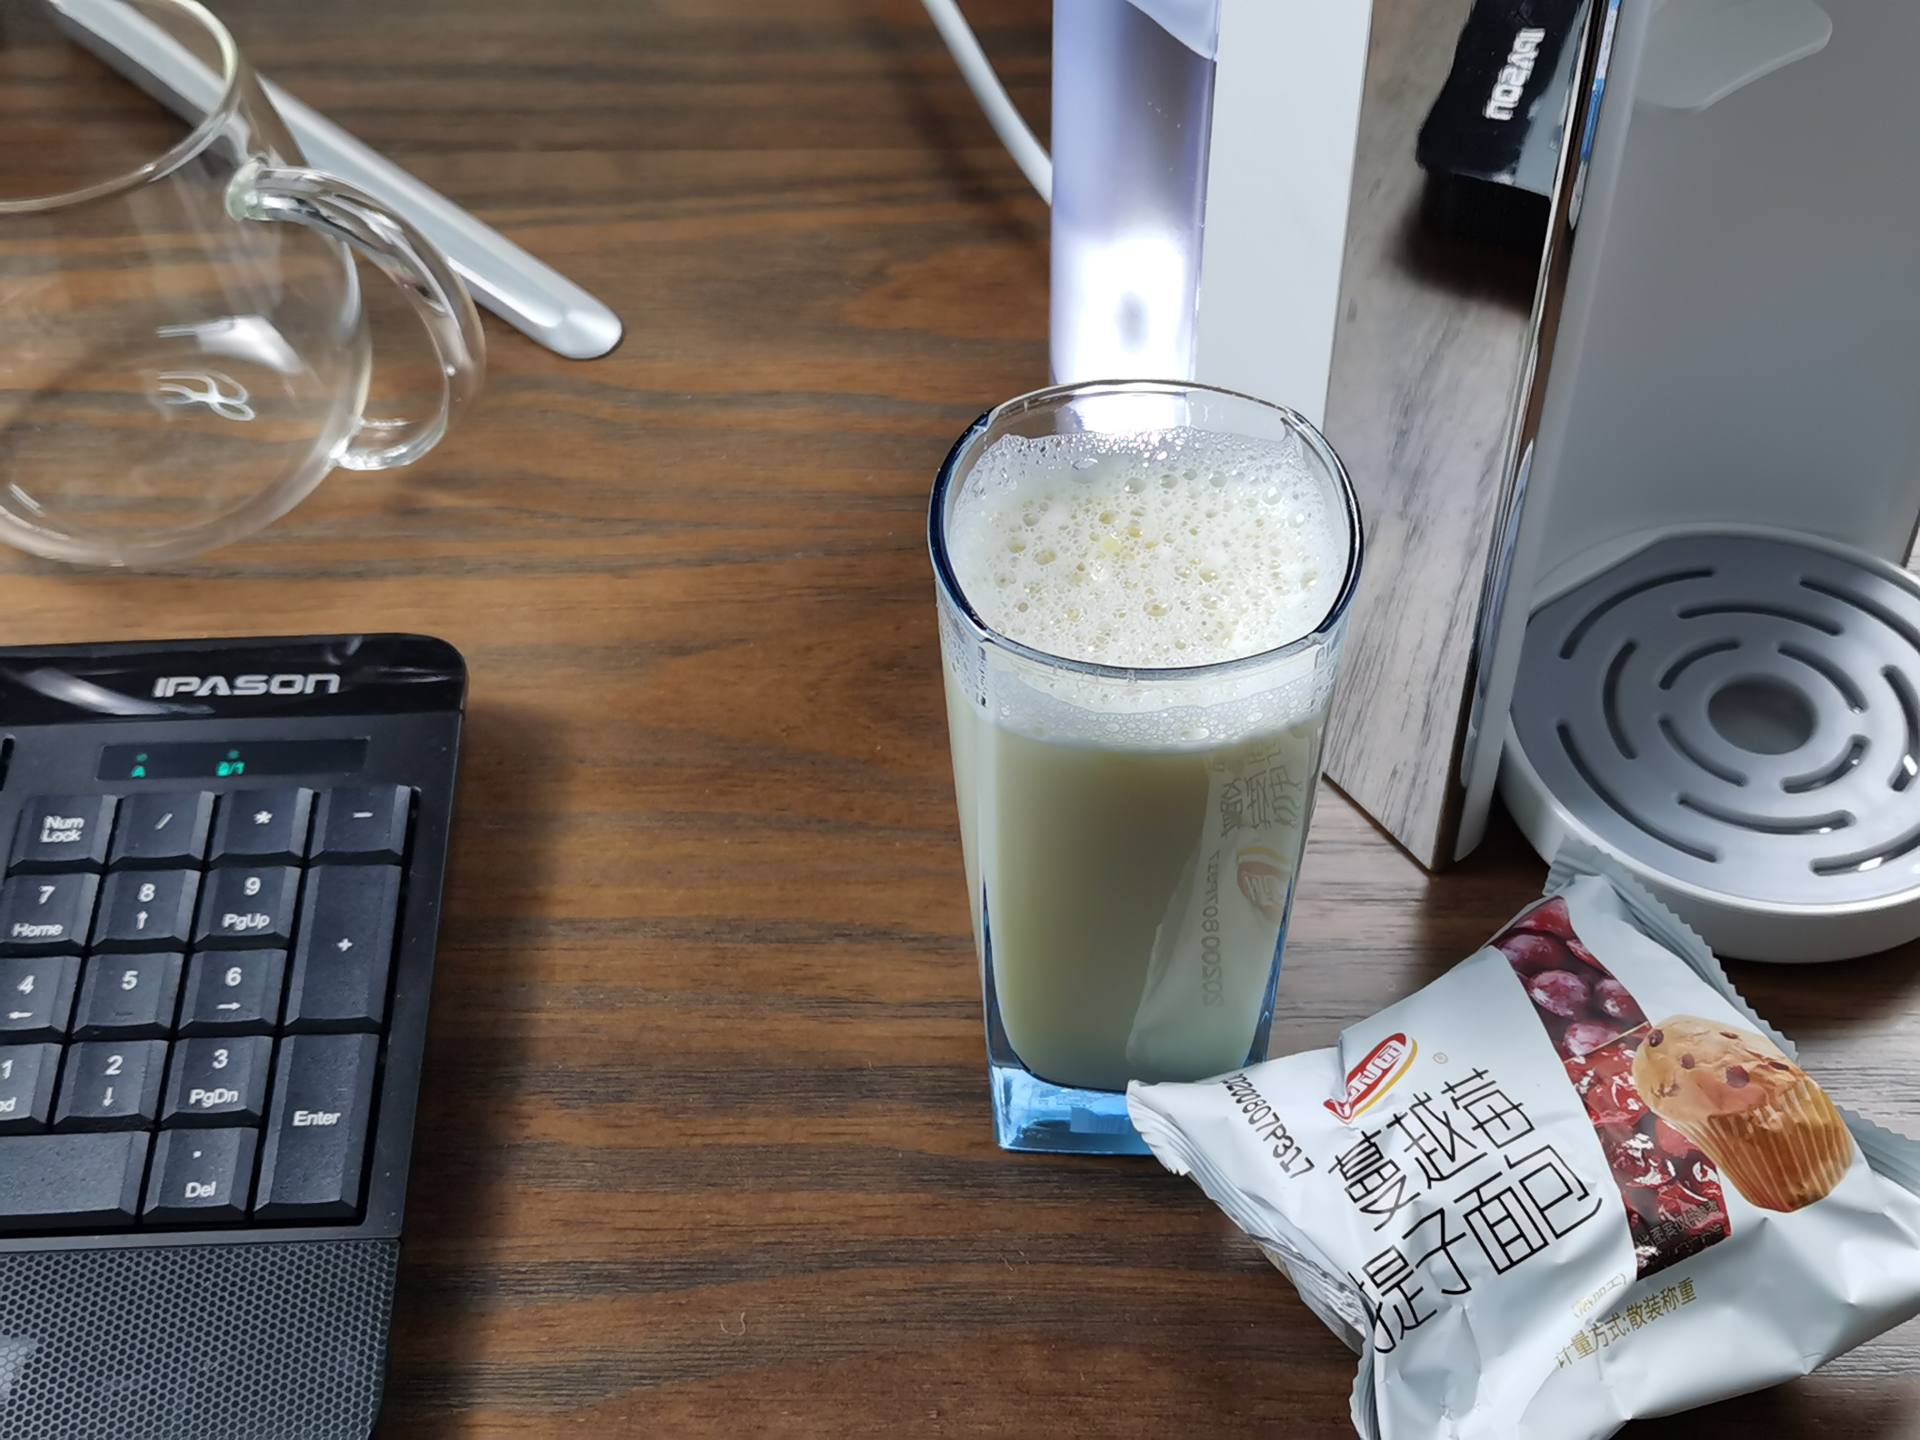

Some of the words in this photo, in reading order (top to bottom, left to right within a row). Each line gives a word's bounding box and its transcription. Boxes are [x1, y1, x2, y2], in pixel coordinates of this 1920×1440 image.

[153, 673, 341, 698] IPASON
[44, 815, 85, 829] Num
[40, 829, 81, 843] Lock
[38, 885, 56, 905] 7
[138, 884, 156, 902] 8
[243, 877, 262, 896] 9
[12, 922, 64, 937] Home
[222, 912, 271, 931] PgUp
[17, 975, 35, 995] 4
[121, 970, 139, 991] 5
[224, 967, 243, 987] 6
[105, 1055, 124, 1076] 2
[212, 1049, 230, 1070] 3
[1, 1060, 14, 1079] 1
[189, 1088, 239, 1106] PgDn
[292, 1111, 341, 1127] Enter
[1328, 1067, 1535, 1232] 蔓越莓
[185, 1181, 217, 1198] Del
[1347, 1144, 1603, 1354] 提子面包
